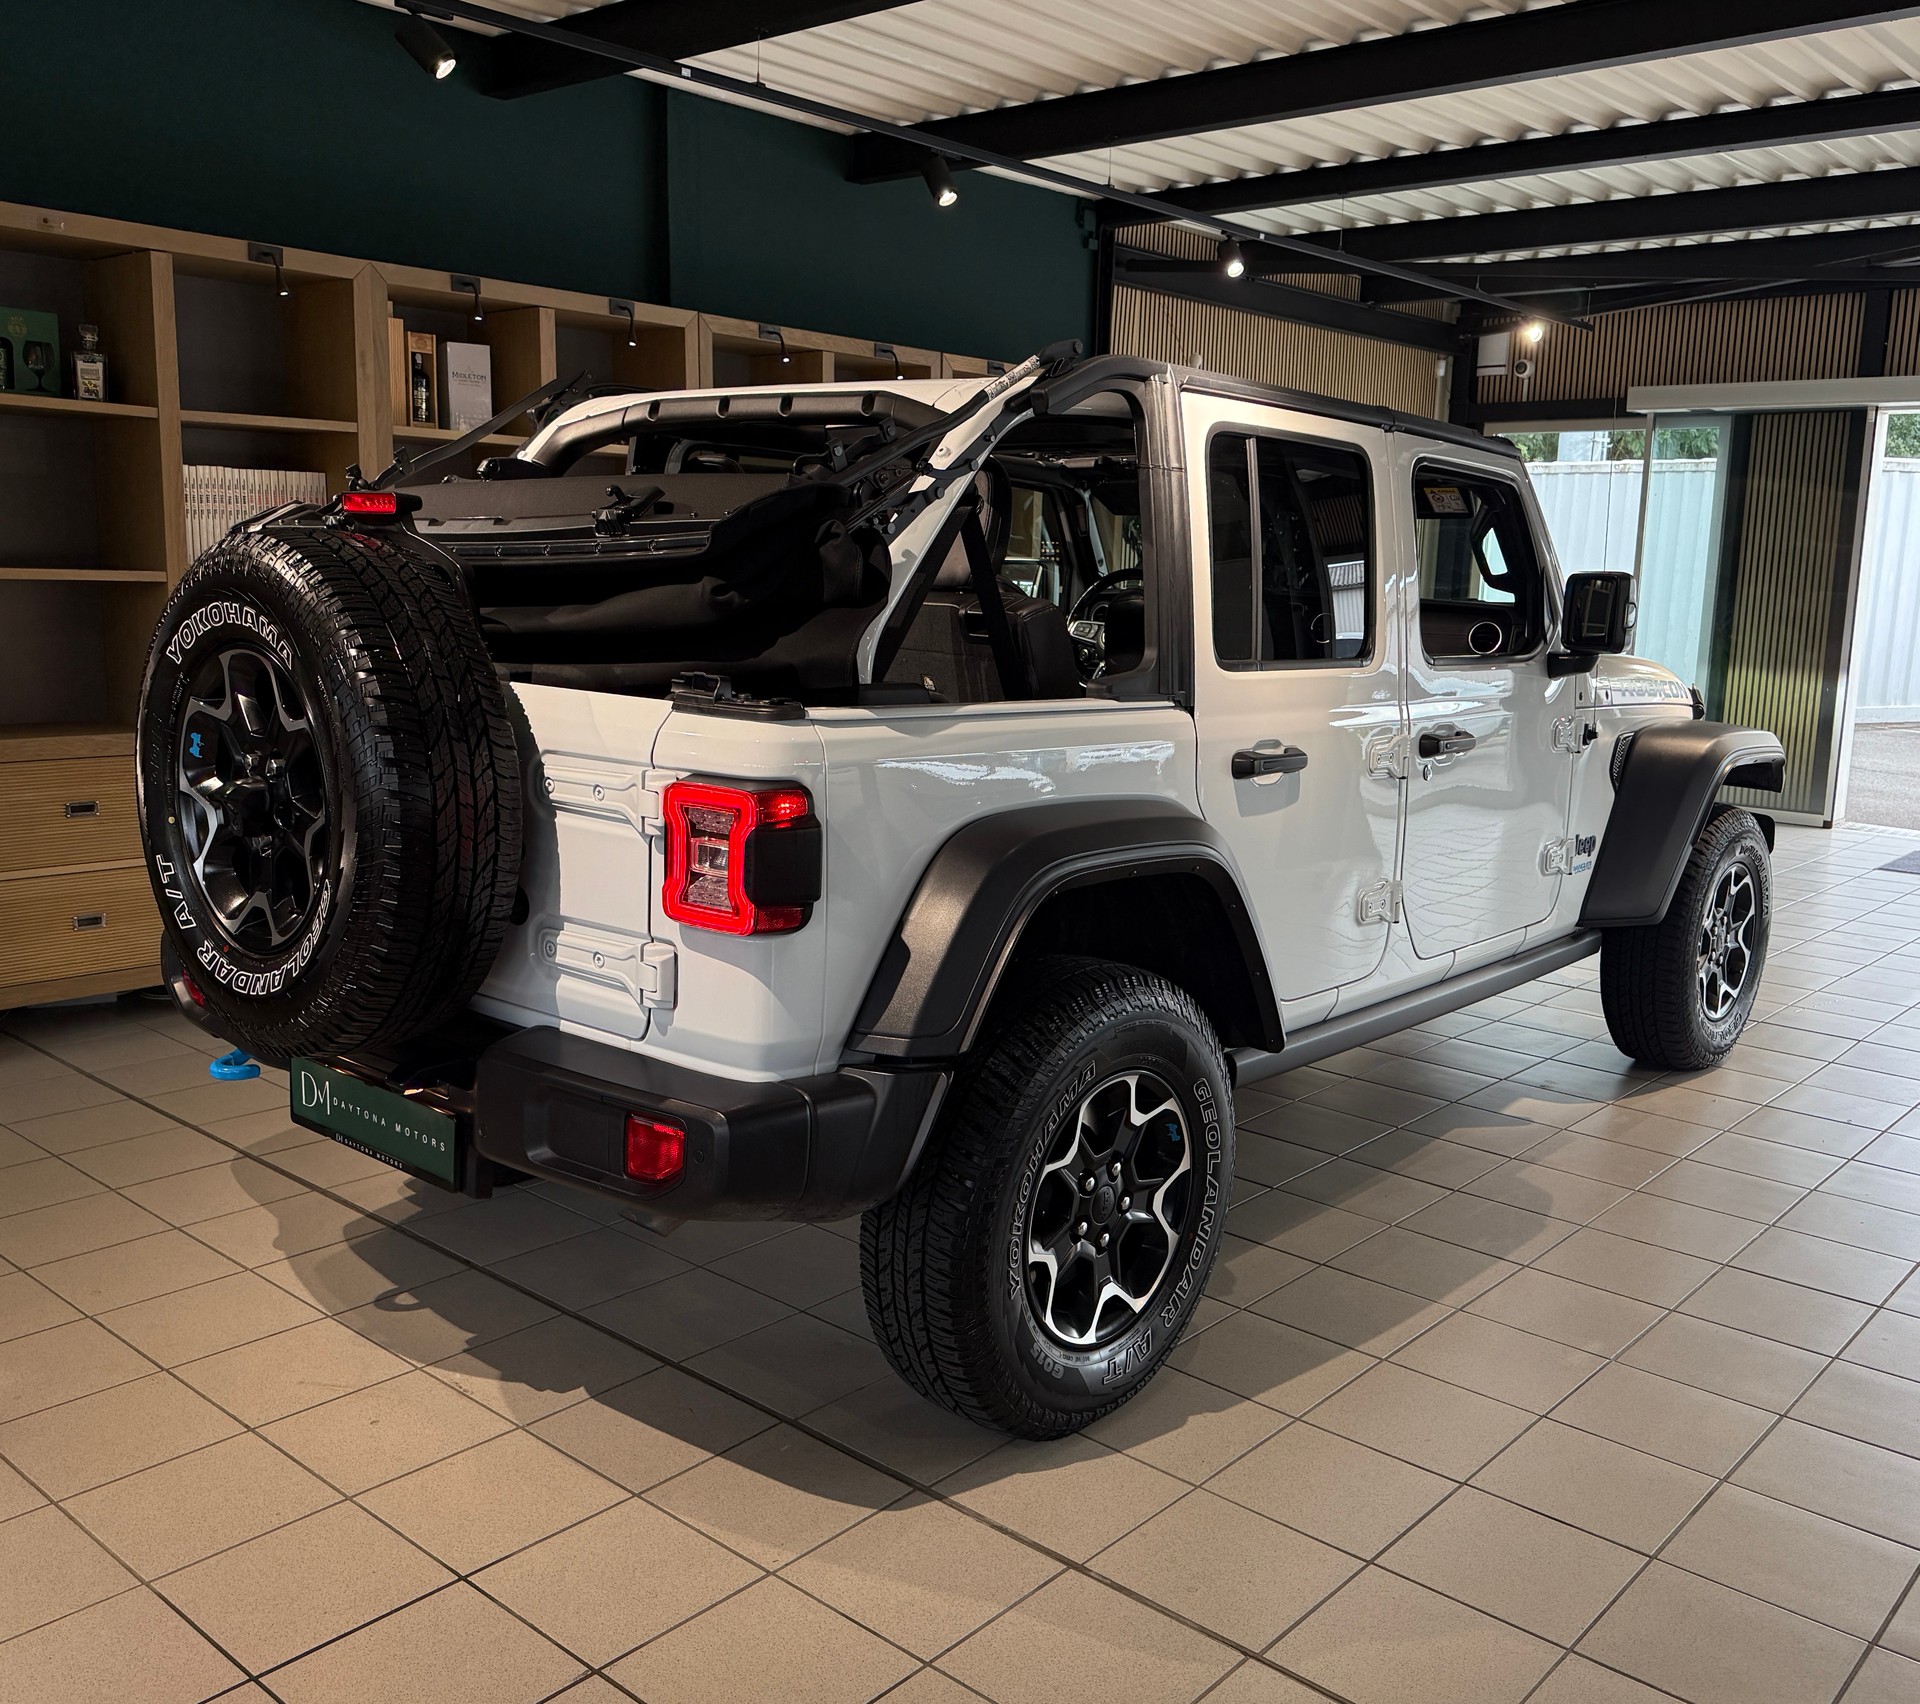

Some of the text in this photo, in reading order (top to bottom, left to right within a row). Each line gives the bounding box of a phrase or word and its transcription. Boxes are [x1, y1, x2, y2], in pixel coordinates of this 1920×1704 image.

[452, 371, 487, 381] MIDLETON
[166, 601, 294, 671] YOKOHAMA
[1621, 680, 1689, 699] RUBICON
[155, 854, 332, 996] GEOLANDAR A/T
[333, 1096, 386, 1127] DAYTONA
[395, 1122, 446, 1152] MOTORS
[1008, 1059, 1097, 1300] YOKOHAMA
[1160, 1077, 1222, 1328] GEOLANDAR
[1029, 1342, 1065, 1380] G015
[1102, 1326, 1152, 1385] A/T
